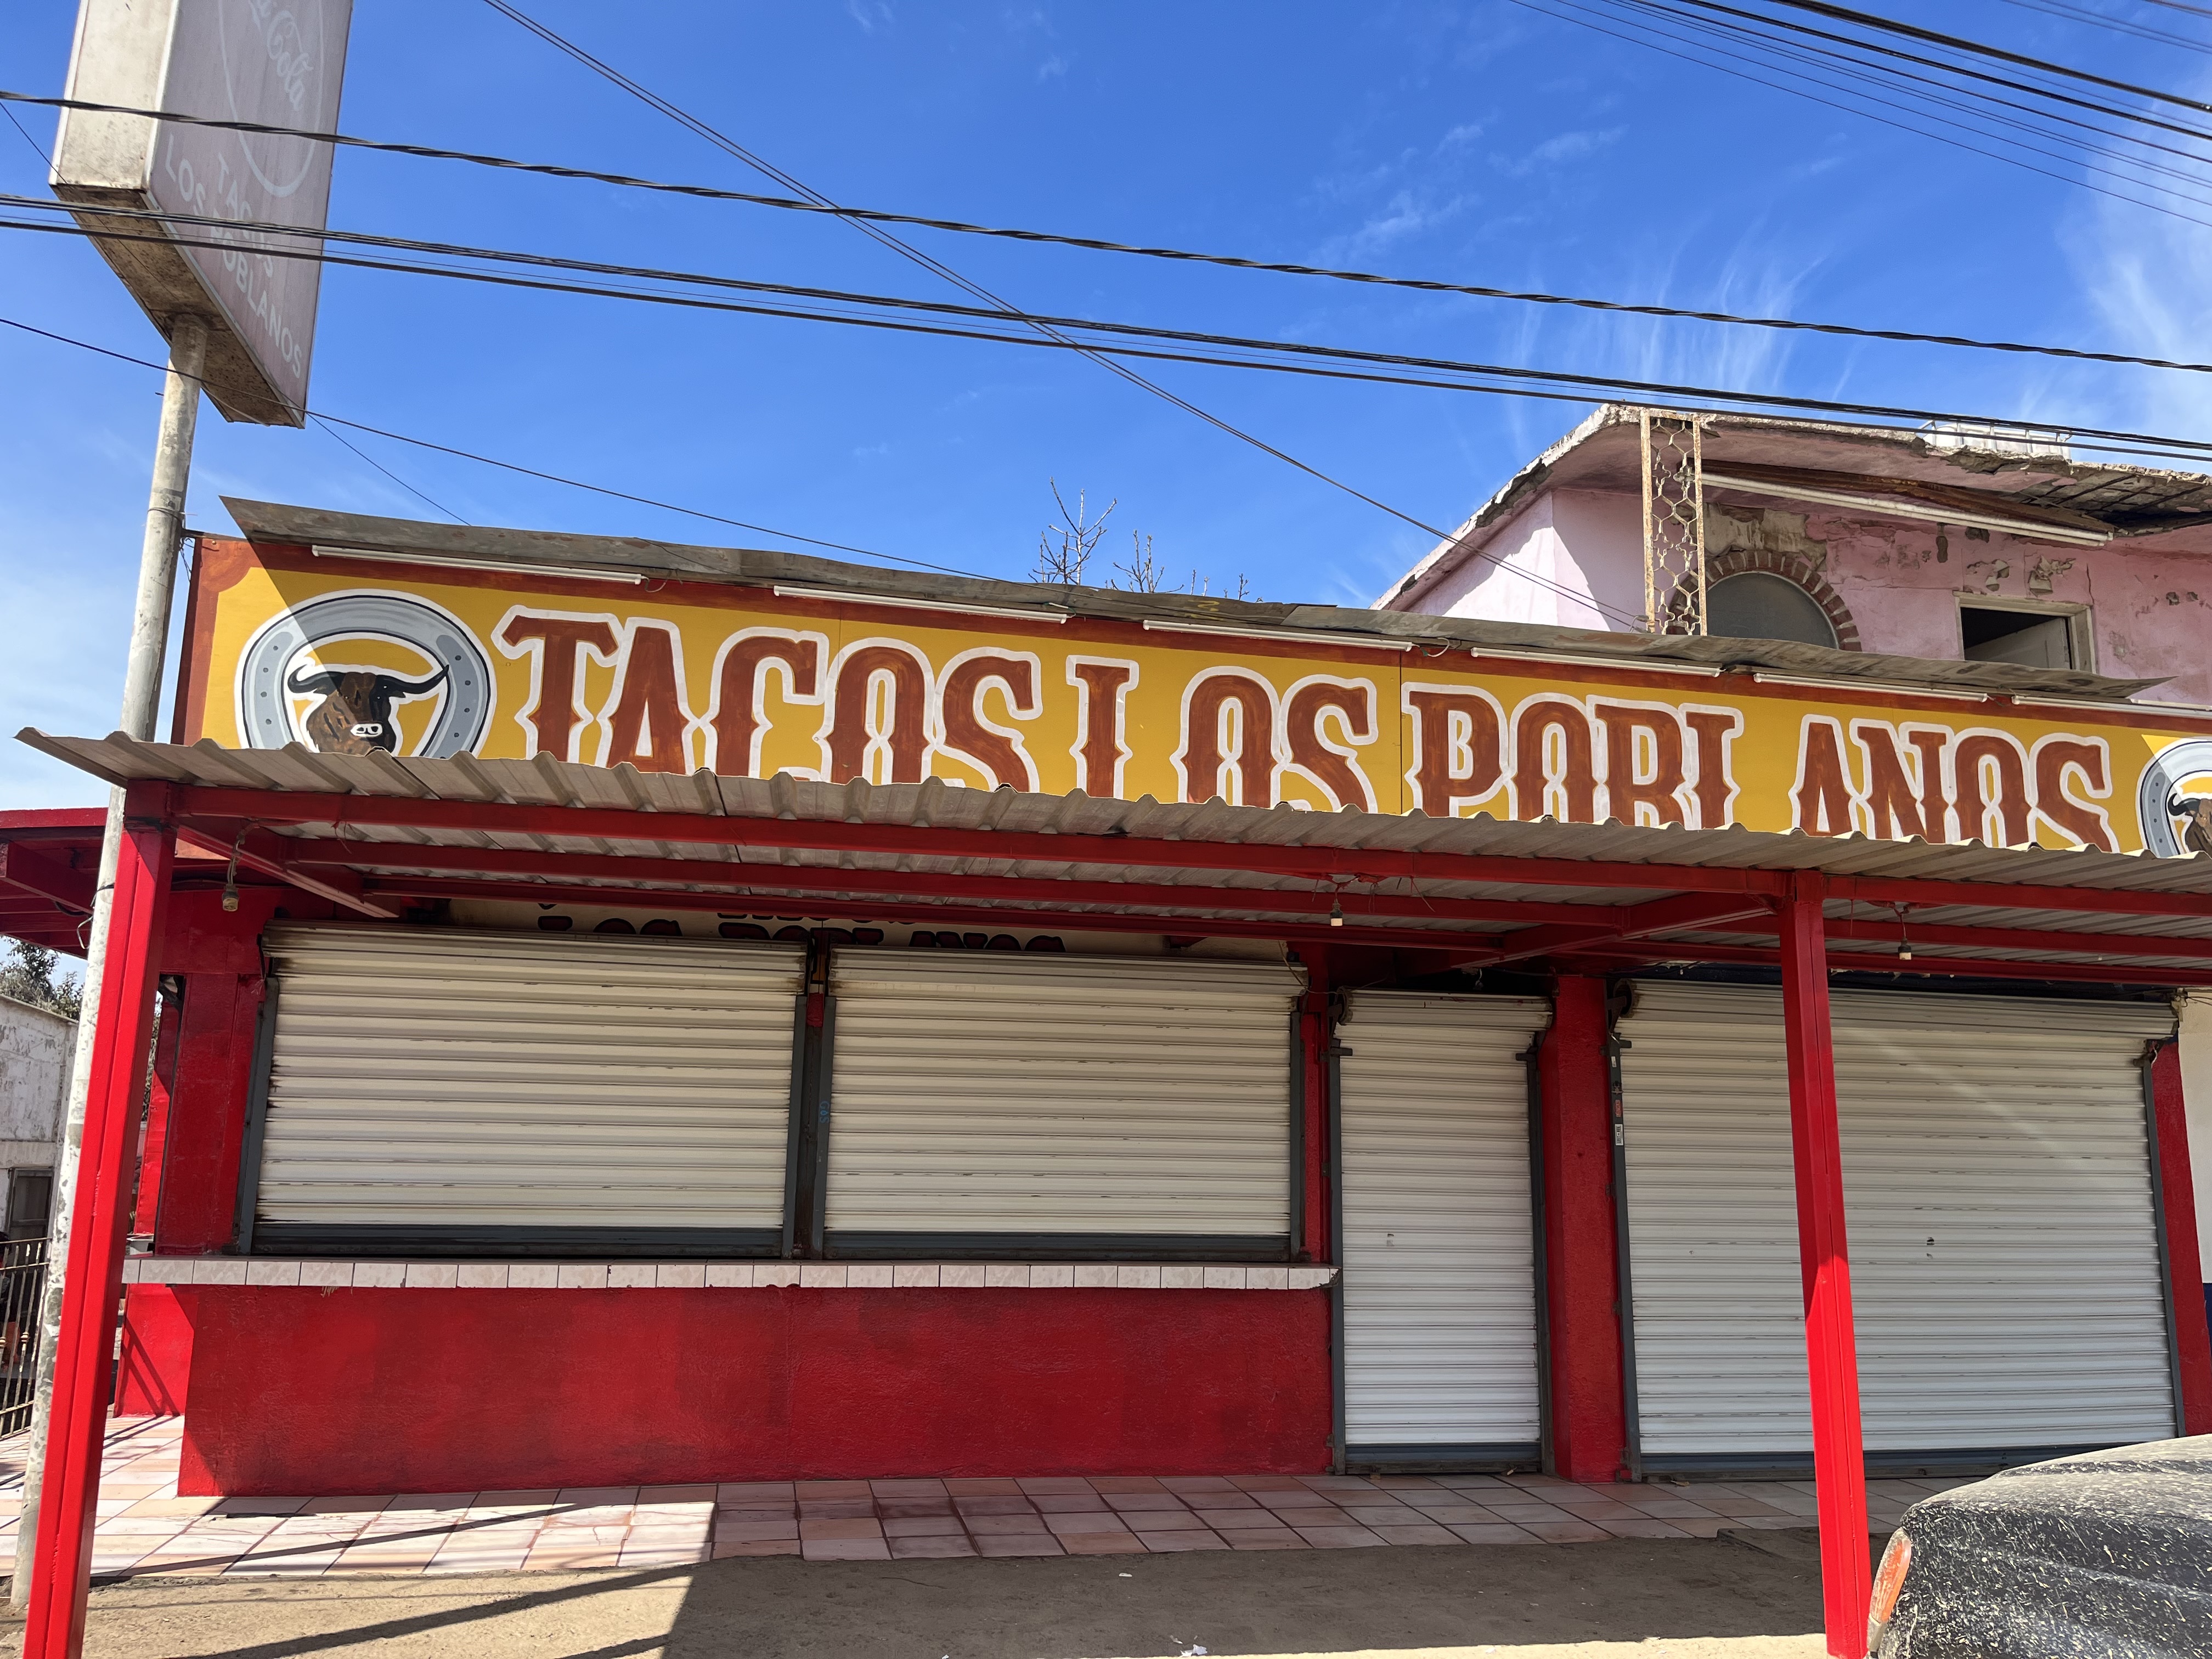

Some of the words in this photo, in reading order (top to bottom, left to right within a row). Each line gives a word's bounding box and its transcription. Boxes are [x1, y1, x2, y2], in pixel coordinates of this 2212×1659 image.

[266, 9, 315, 111] Cola
[165, 132, 206, 217] LOS
[492, 605, 1042, 793] TACOS
